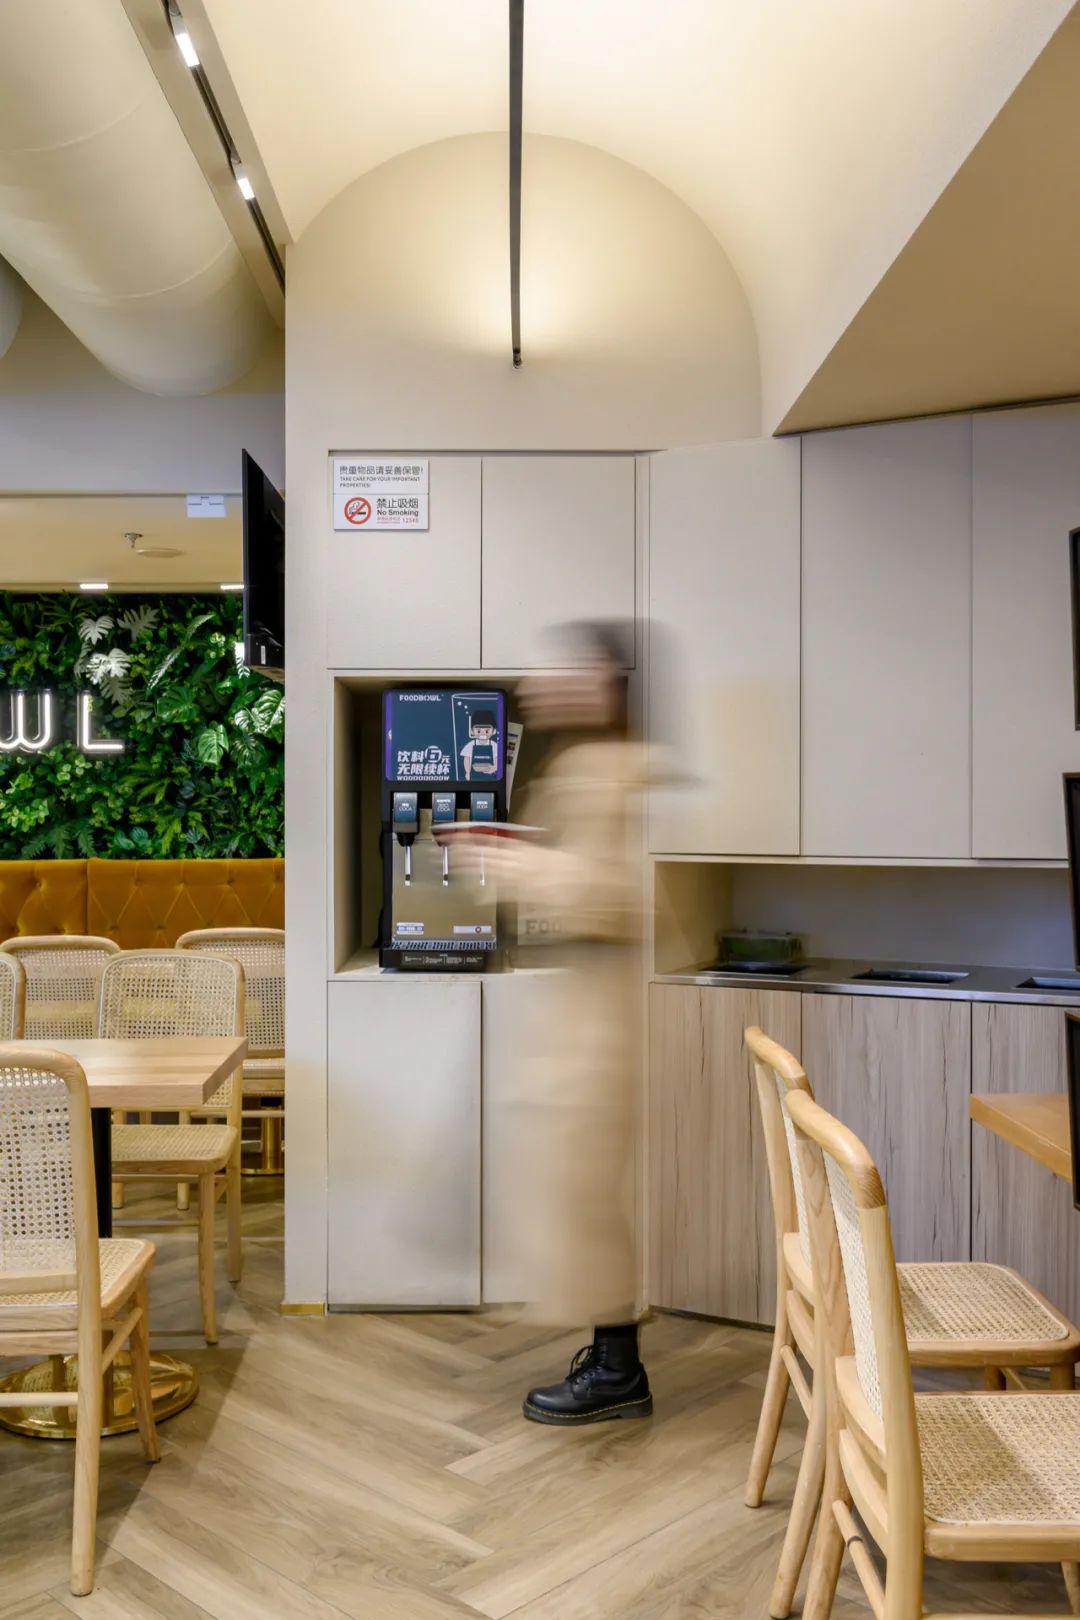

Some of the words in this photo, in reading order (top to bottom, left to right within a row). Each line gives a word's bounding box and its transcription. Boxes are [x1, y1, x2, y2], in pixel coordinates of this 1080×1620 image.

[376, 498, 419, 509] 禁止吸烟
[388, 509, 419, 517] Smoking
[399, 694, 442, 702] FOODBOWL
[396, 763, 451, 775] 无限续杯
